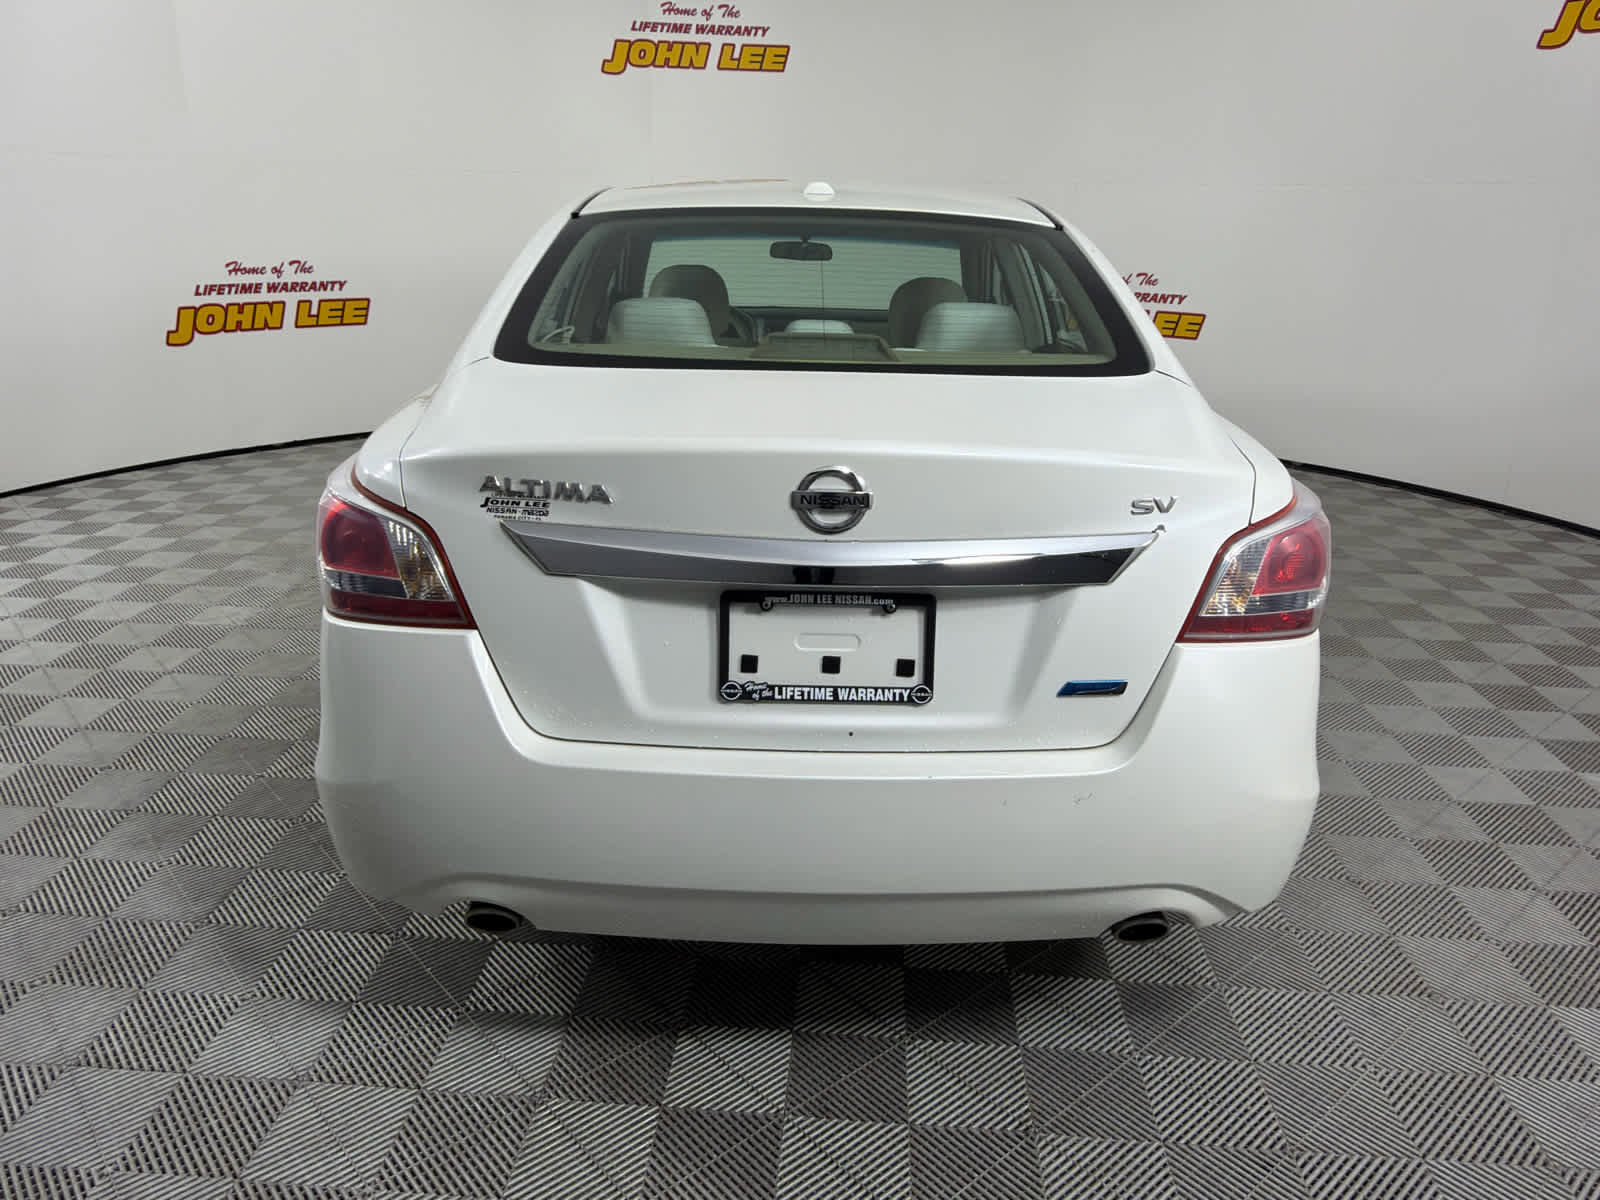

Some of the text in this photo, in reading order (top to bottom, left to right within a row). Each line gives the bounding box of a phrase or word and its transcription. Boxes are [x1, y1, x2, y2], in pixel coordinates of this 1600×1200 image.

[660, 1, 741, 21] Home of The
[631, 21, 770, 37] LIFETIME WARRANTY
[601, 39, 790, 75] JOHN LEE
[225, 260, 314, 279] Home of The
[194, 280, 347, 297] LIFETIME WARRANTY
[1135, 272, 1159, 287] The
[1134, 292, 1188, 305] RRANTY
[166, 298, 370, 347] JOHN LEE
[1152, 309, 1207, 341] EE
[479, 474, 614, 504] ALTIMA
[480, 497, 521, 508] JOHN
[800, 494, 865, 506] NISSAN
[1130, 496, 1177, 515] SV
[774, 686, 910, 702] LIFETIME WARRANTY
